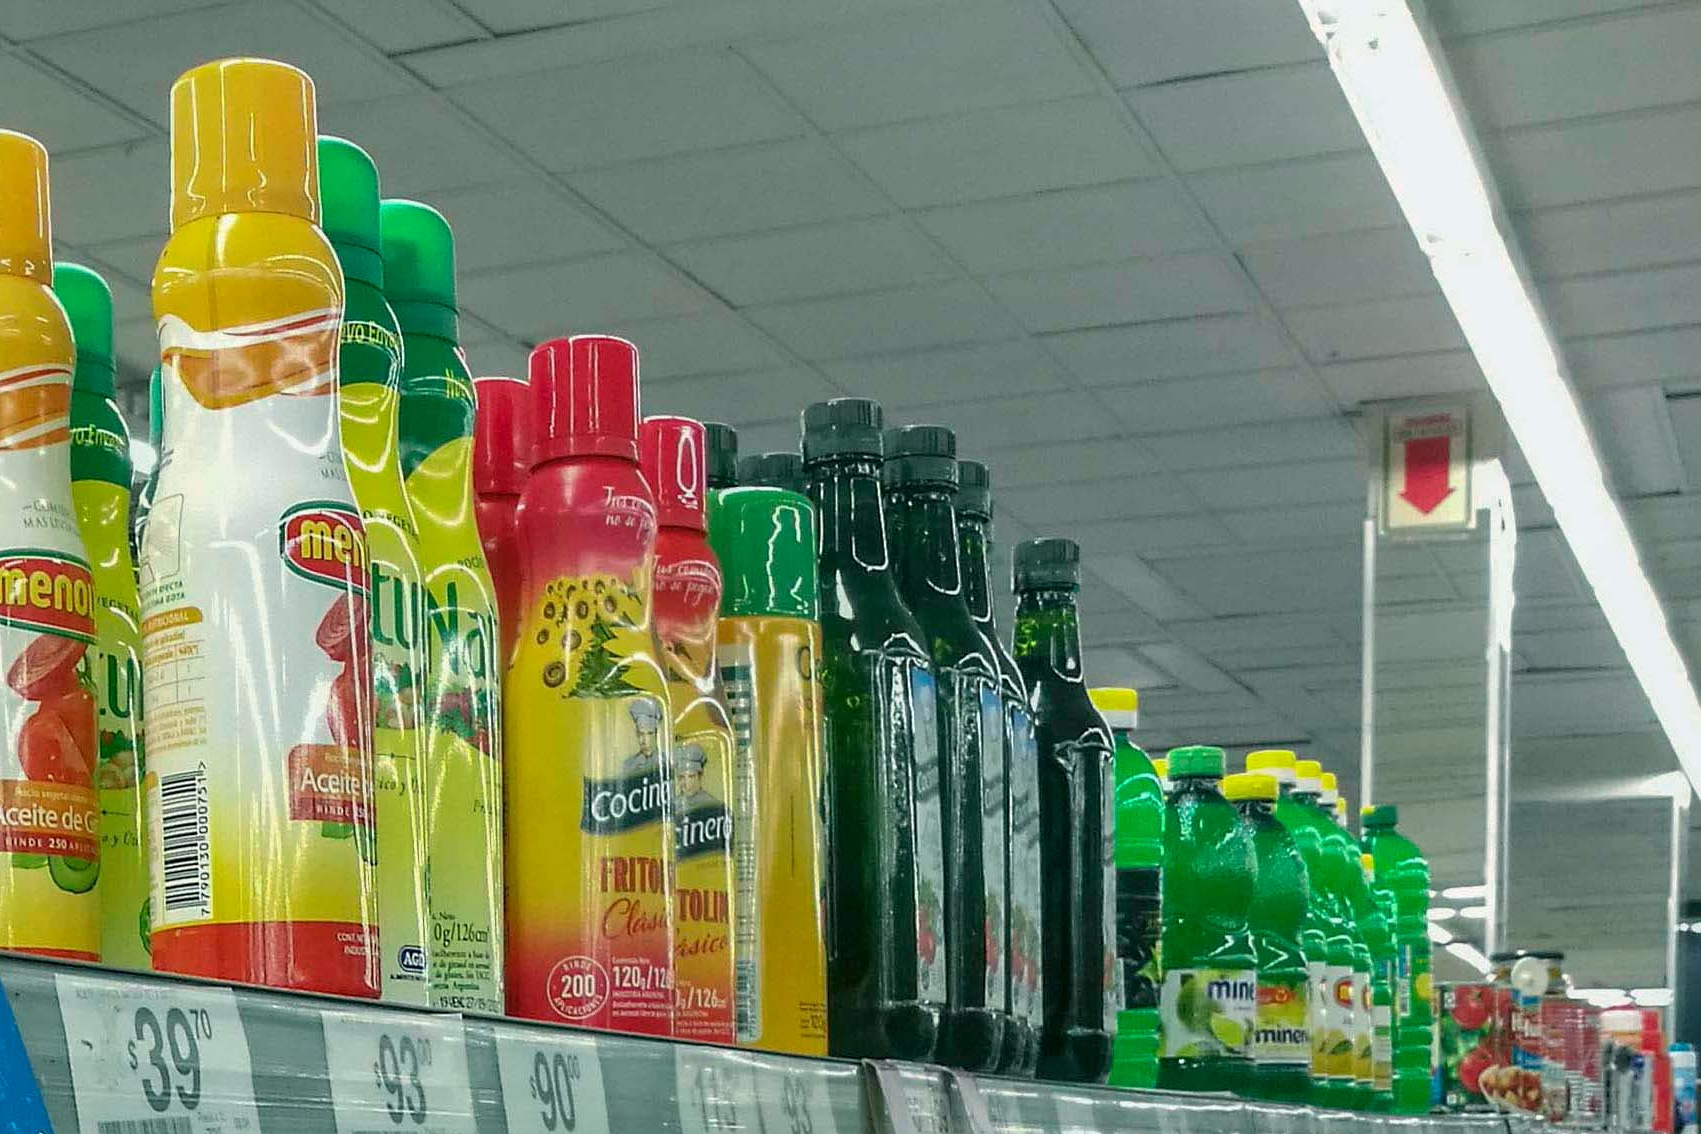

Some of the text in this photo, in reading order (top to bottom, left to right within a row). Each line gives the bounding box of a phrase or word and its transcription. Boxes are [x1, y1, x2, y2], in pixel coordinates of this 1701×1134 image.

[300, 767, 361, 792] Aceite
[62, 807, 83, 832] de
[48, 837, 68, 850] 250
[561, 974, 596, 998] 200
[553, 994, 604, 1017] APLICACIONES
